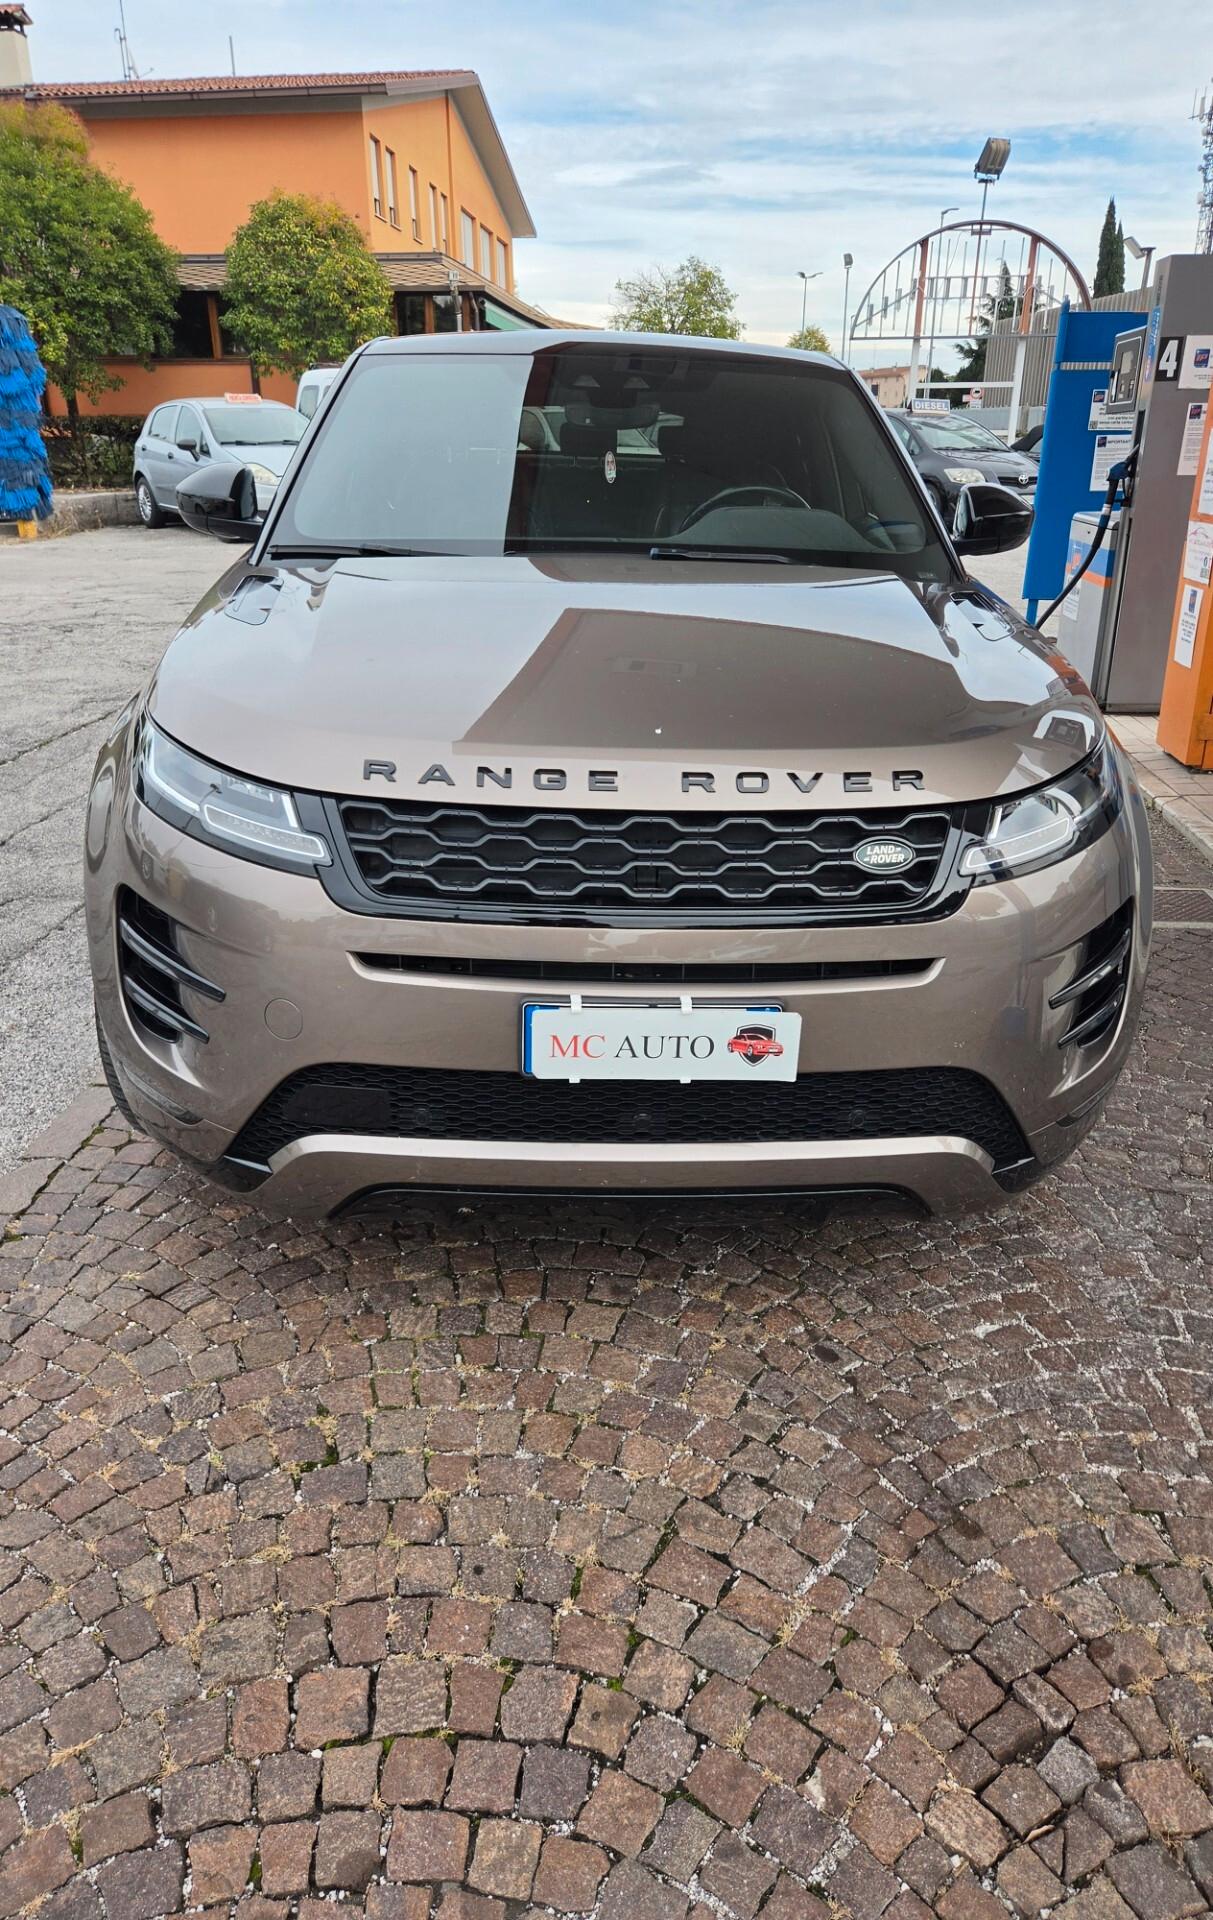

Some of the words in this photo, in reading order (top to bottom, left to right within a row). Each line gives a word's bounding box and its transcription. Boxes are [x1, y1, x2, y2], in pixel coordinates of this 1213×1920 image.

[1158, 339, 1179, 378] 4
[915, 401, 948, 410] DIESEL
[362, 758, 619, 792] RANGE
[681, 769, 926, 794] ROVER
[870, 854, 905, 863] ROVER
[550, 1034, 606, 1059] MC
[613, 1034, 716, 1059] AUTO
